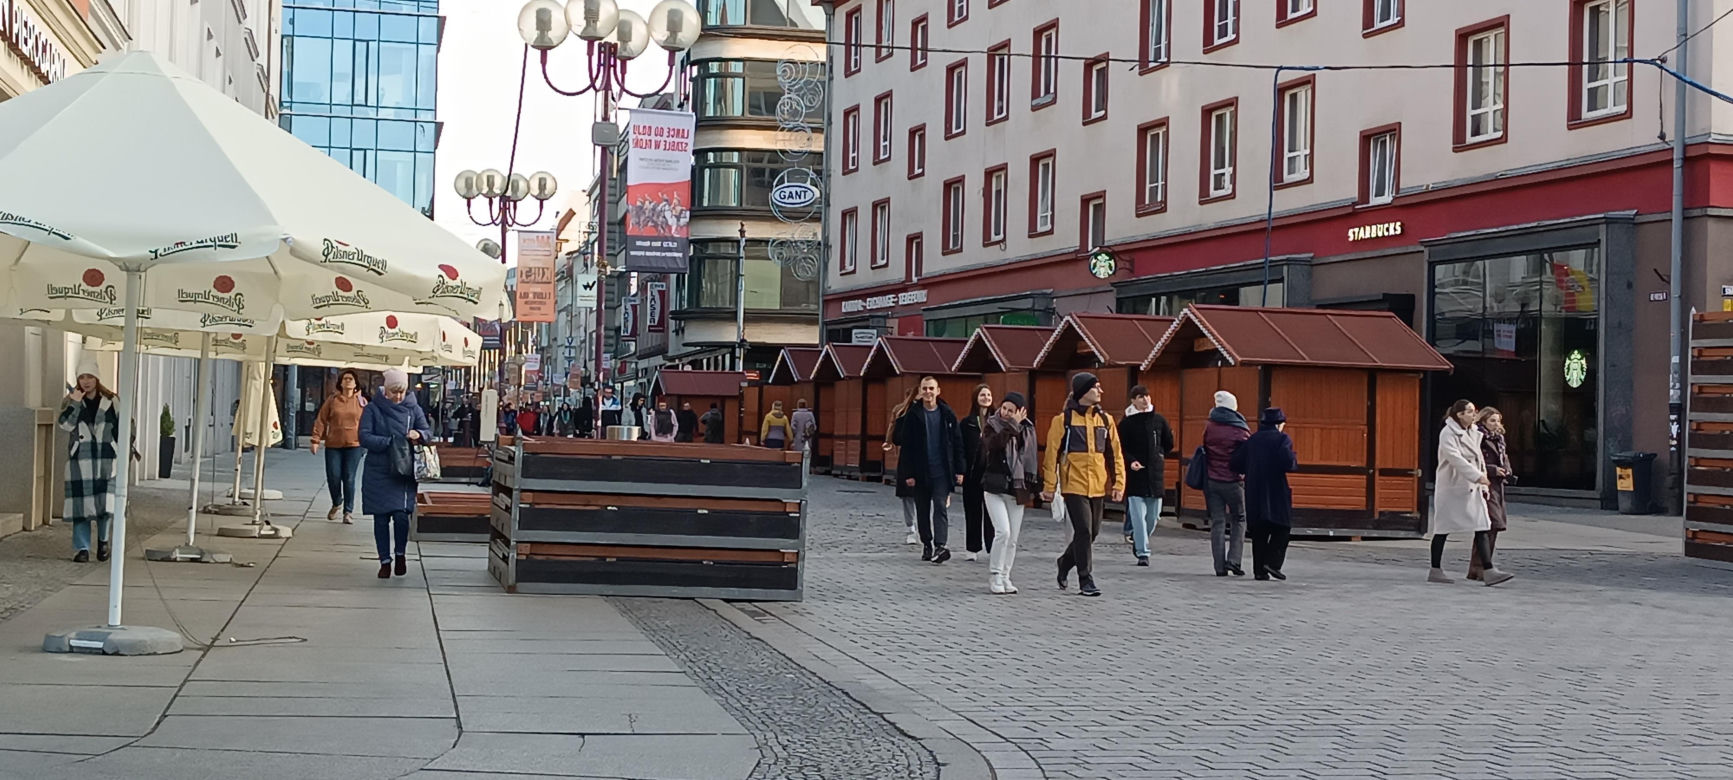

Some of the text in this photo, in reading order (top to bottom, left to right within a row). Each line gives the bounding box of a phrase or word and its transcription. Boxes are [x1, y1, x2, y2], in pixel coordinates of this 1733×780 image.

[778, 190, 808, 200] GANT
[1348, 221, 1402, 241] STARBUCKS
[321, 238, 388, 273] Pilsner Urquell
